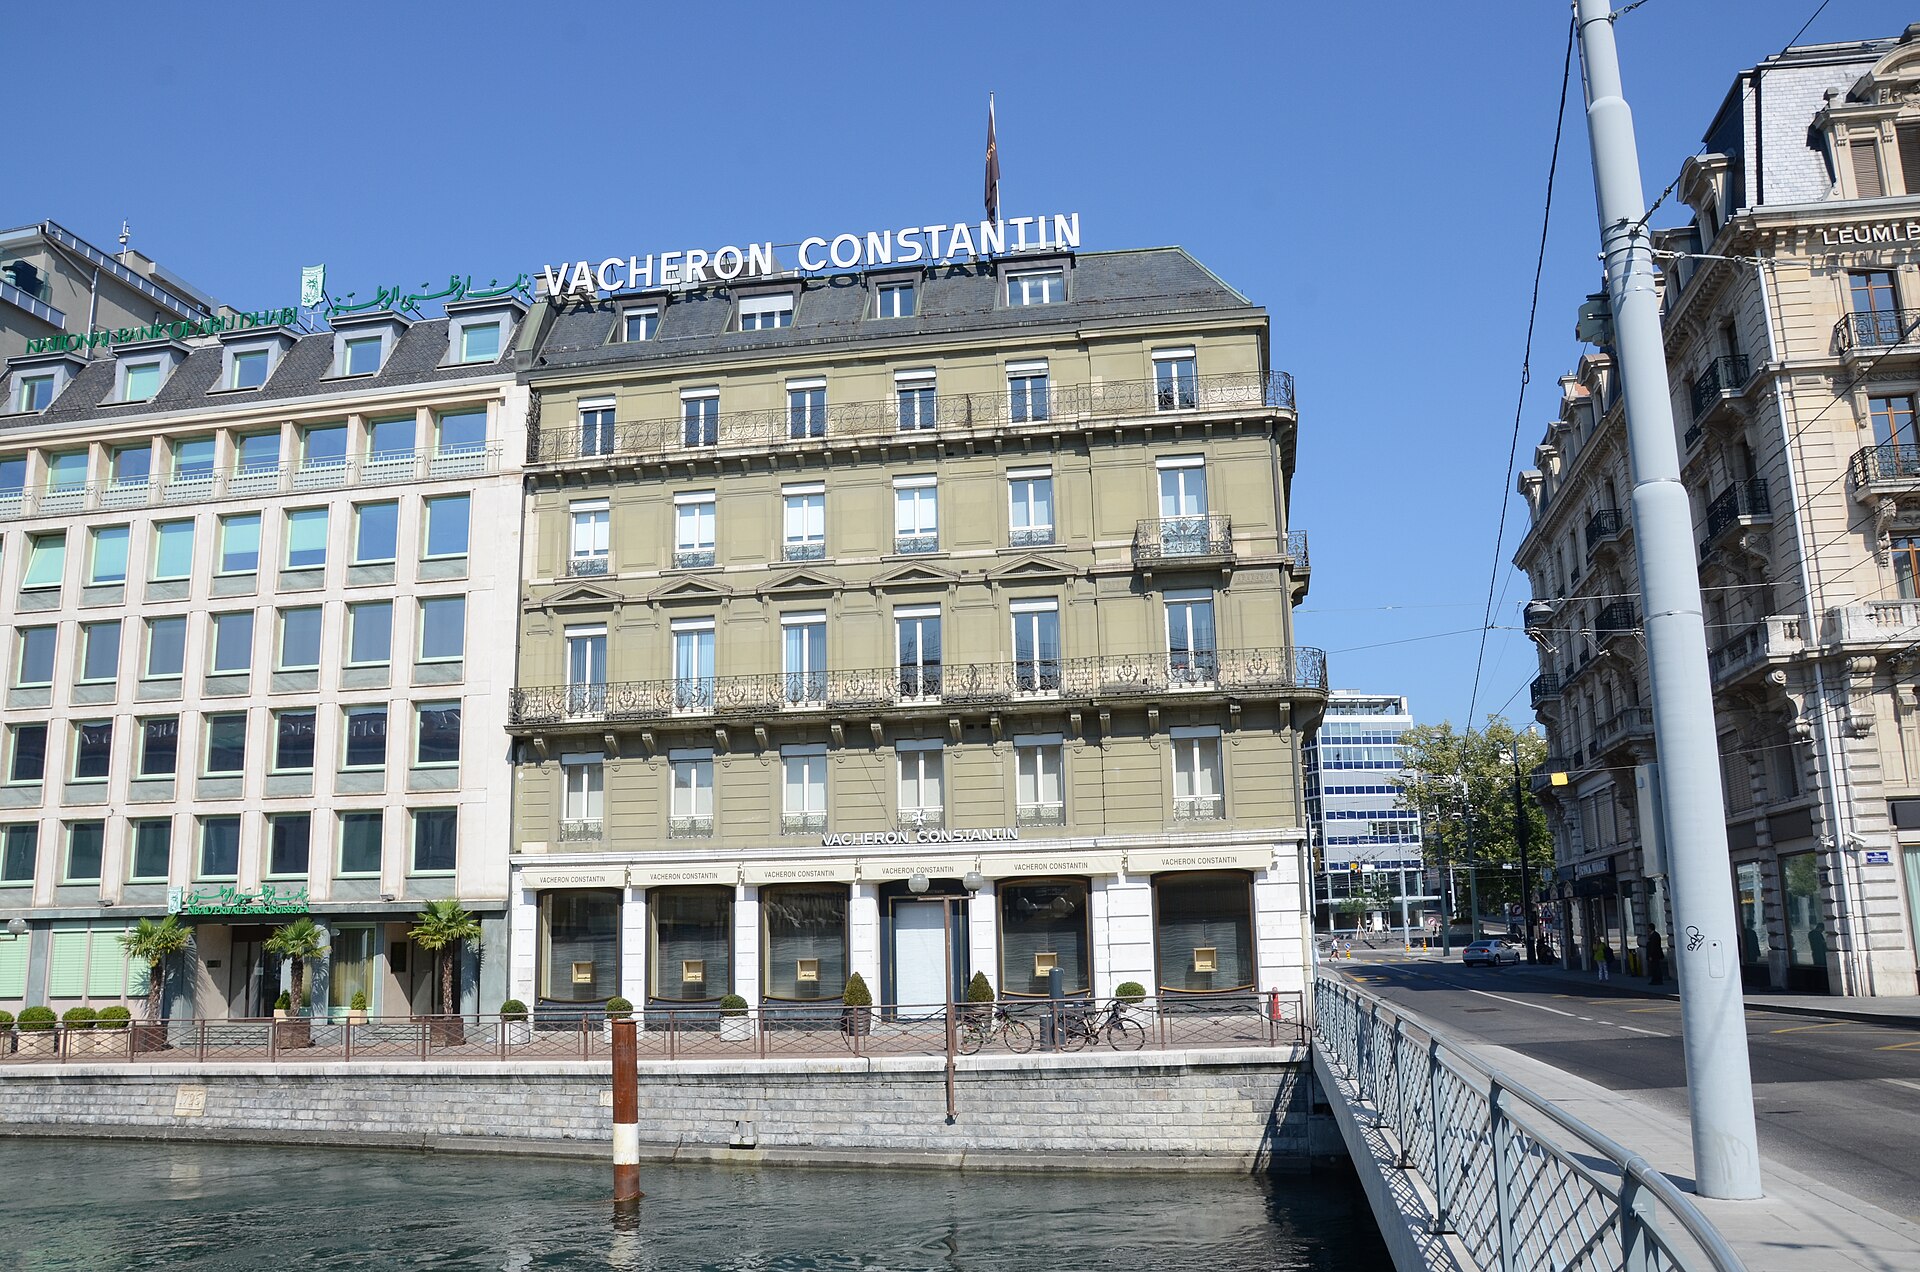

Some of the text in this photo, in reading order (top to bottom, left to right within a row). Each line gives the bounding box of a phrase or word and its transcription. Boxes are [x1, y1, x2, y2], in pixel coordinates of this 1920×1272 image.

[1822, 226, 1899, 246] LEUMI
[544, 212, 1080, 297] VACHERON CONSTANTIN
[26, 306, 298, 354] NATIONAL BANK OF ABU DHABI
[822, 828, 1019, 847] VACHERON CONSTANTIN
[1161, 856, 1238, 866] VACHERON CONSTANTIN
[881, 865, 954, 875] VACHERON CONSTANTIN
[1013, 862, 1088, 871] VACHERON CONSTANTIN
[649, 872, 718, 881] VACHERON CONSTANTIN
[763, 869, 835, 878] VACHERON CONSTANTIN
[540, 875, 606, 884] VACHERON CONSTANTIN
[187, 905, 213, 915] NBAD
[214, 905, 246, 915] PRIVATE
[246, 905, 269, 915] BANK
